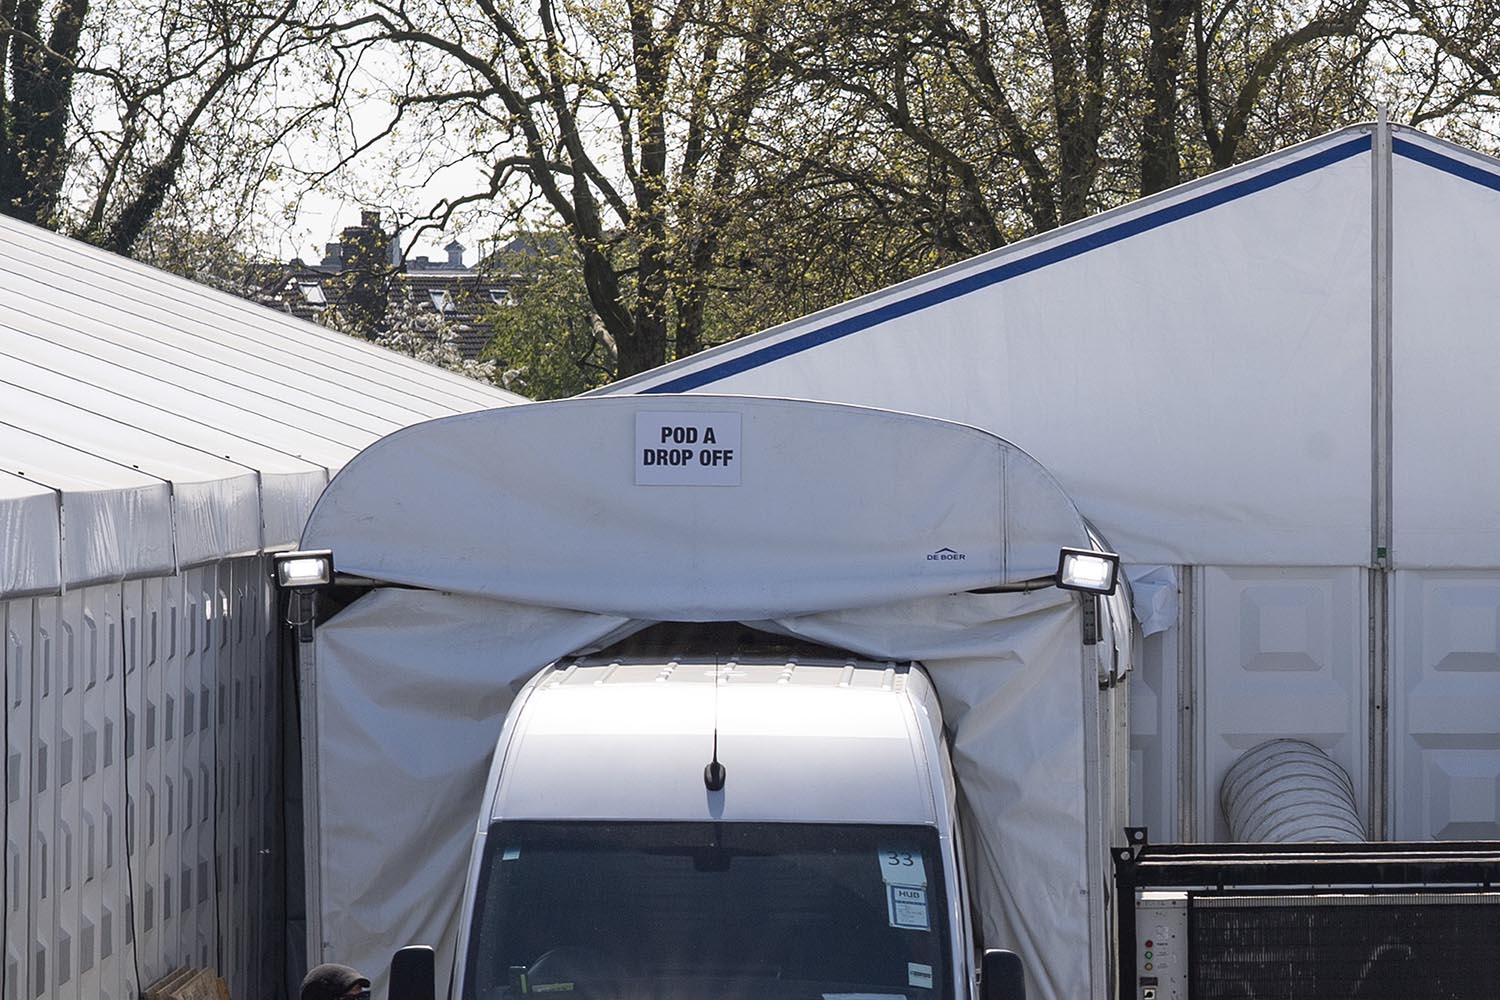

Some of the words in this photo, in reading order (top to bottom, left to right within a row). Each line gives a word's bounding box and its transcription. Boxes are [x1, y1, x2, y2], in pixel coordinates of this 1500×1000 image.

[661, 427, 698, 444] POD
[703, 427, 717, 444] A
[643, 449, 693, 466] DROP
[699, 449, 734, 466] OFF
[888, 852, 914, 866] 33
[898, 890, 921, 899] HUB
